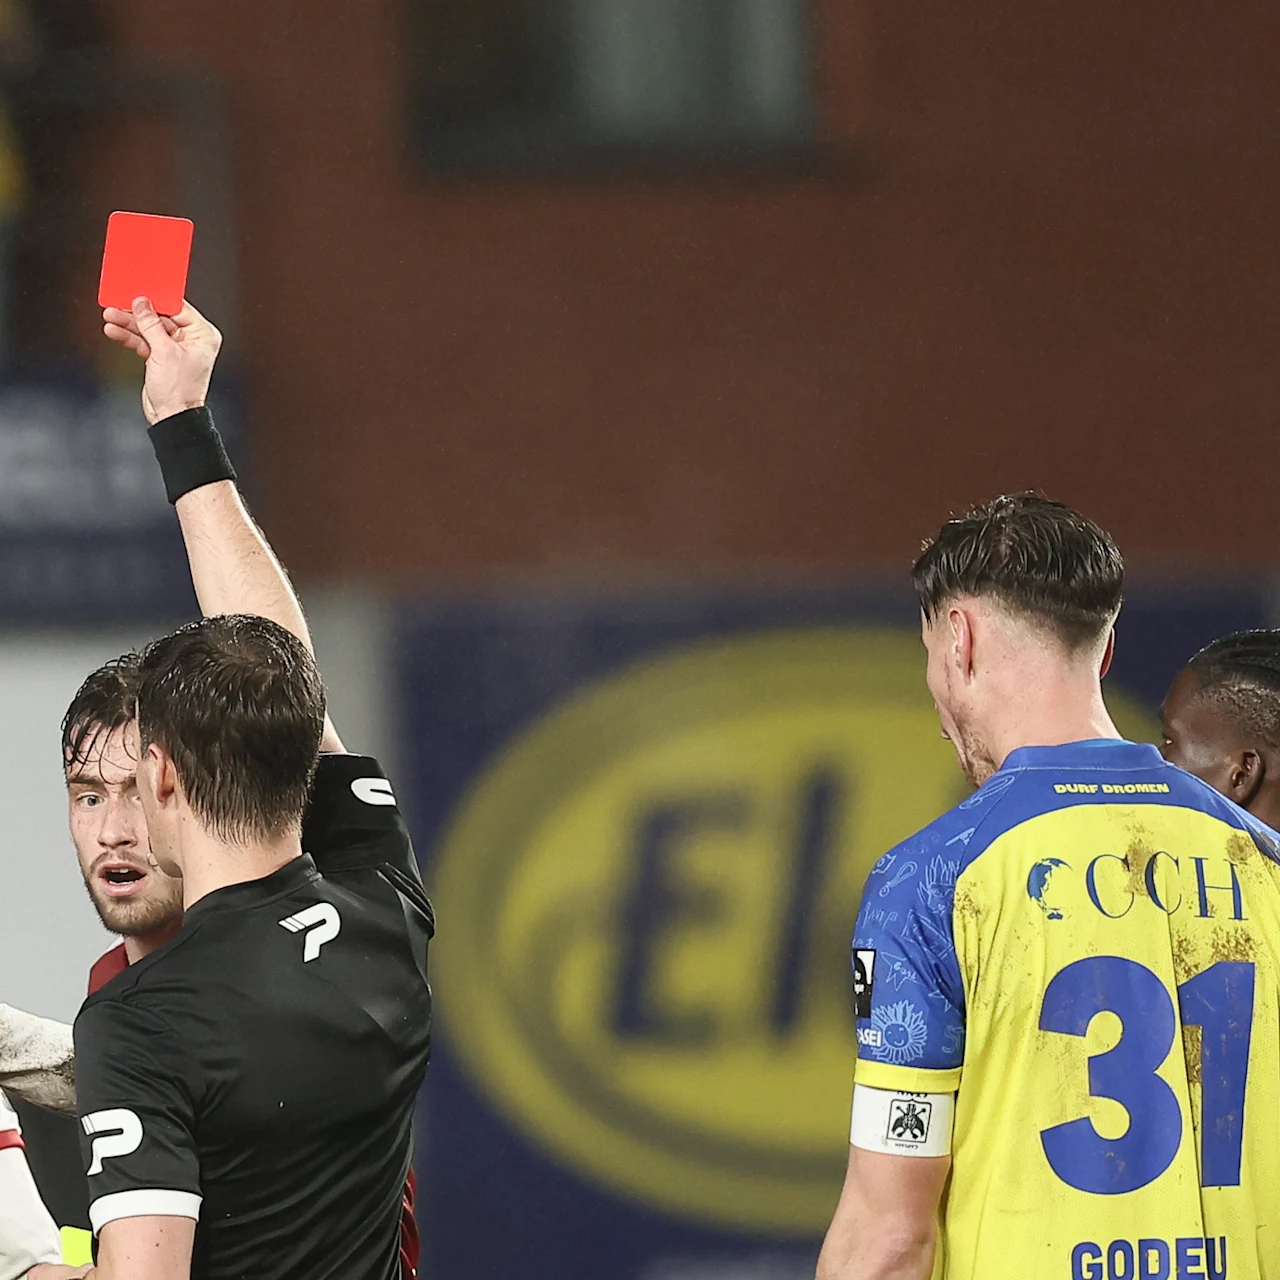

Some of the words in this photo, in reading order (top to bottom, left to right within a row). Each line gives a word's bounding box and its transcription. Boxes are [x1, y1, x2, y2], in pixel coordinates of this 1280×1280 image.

[1053, 783, 1099, 794] DURF
[1101, 783, 1171, 794] DROMEN
[856, 1028, 882, 1047] ASEI
[1037, 955, 1256, 1196] 31
